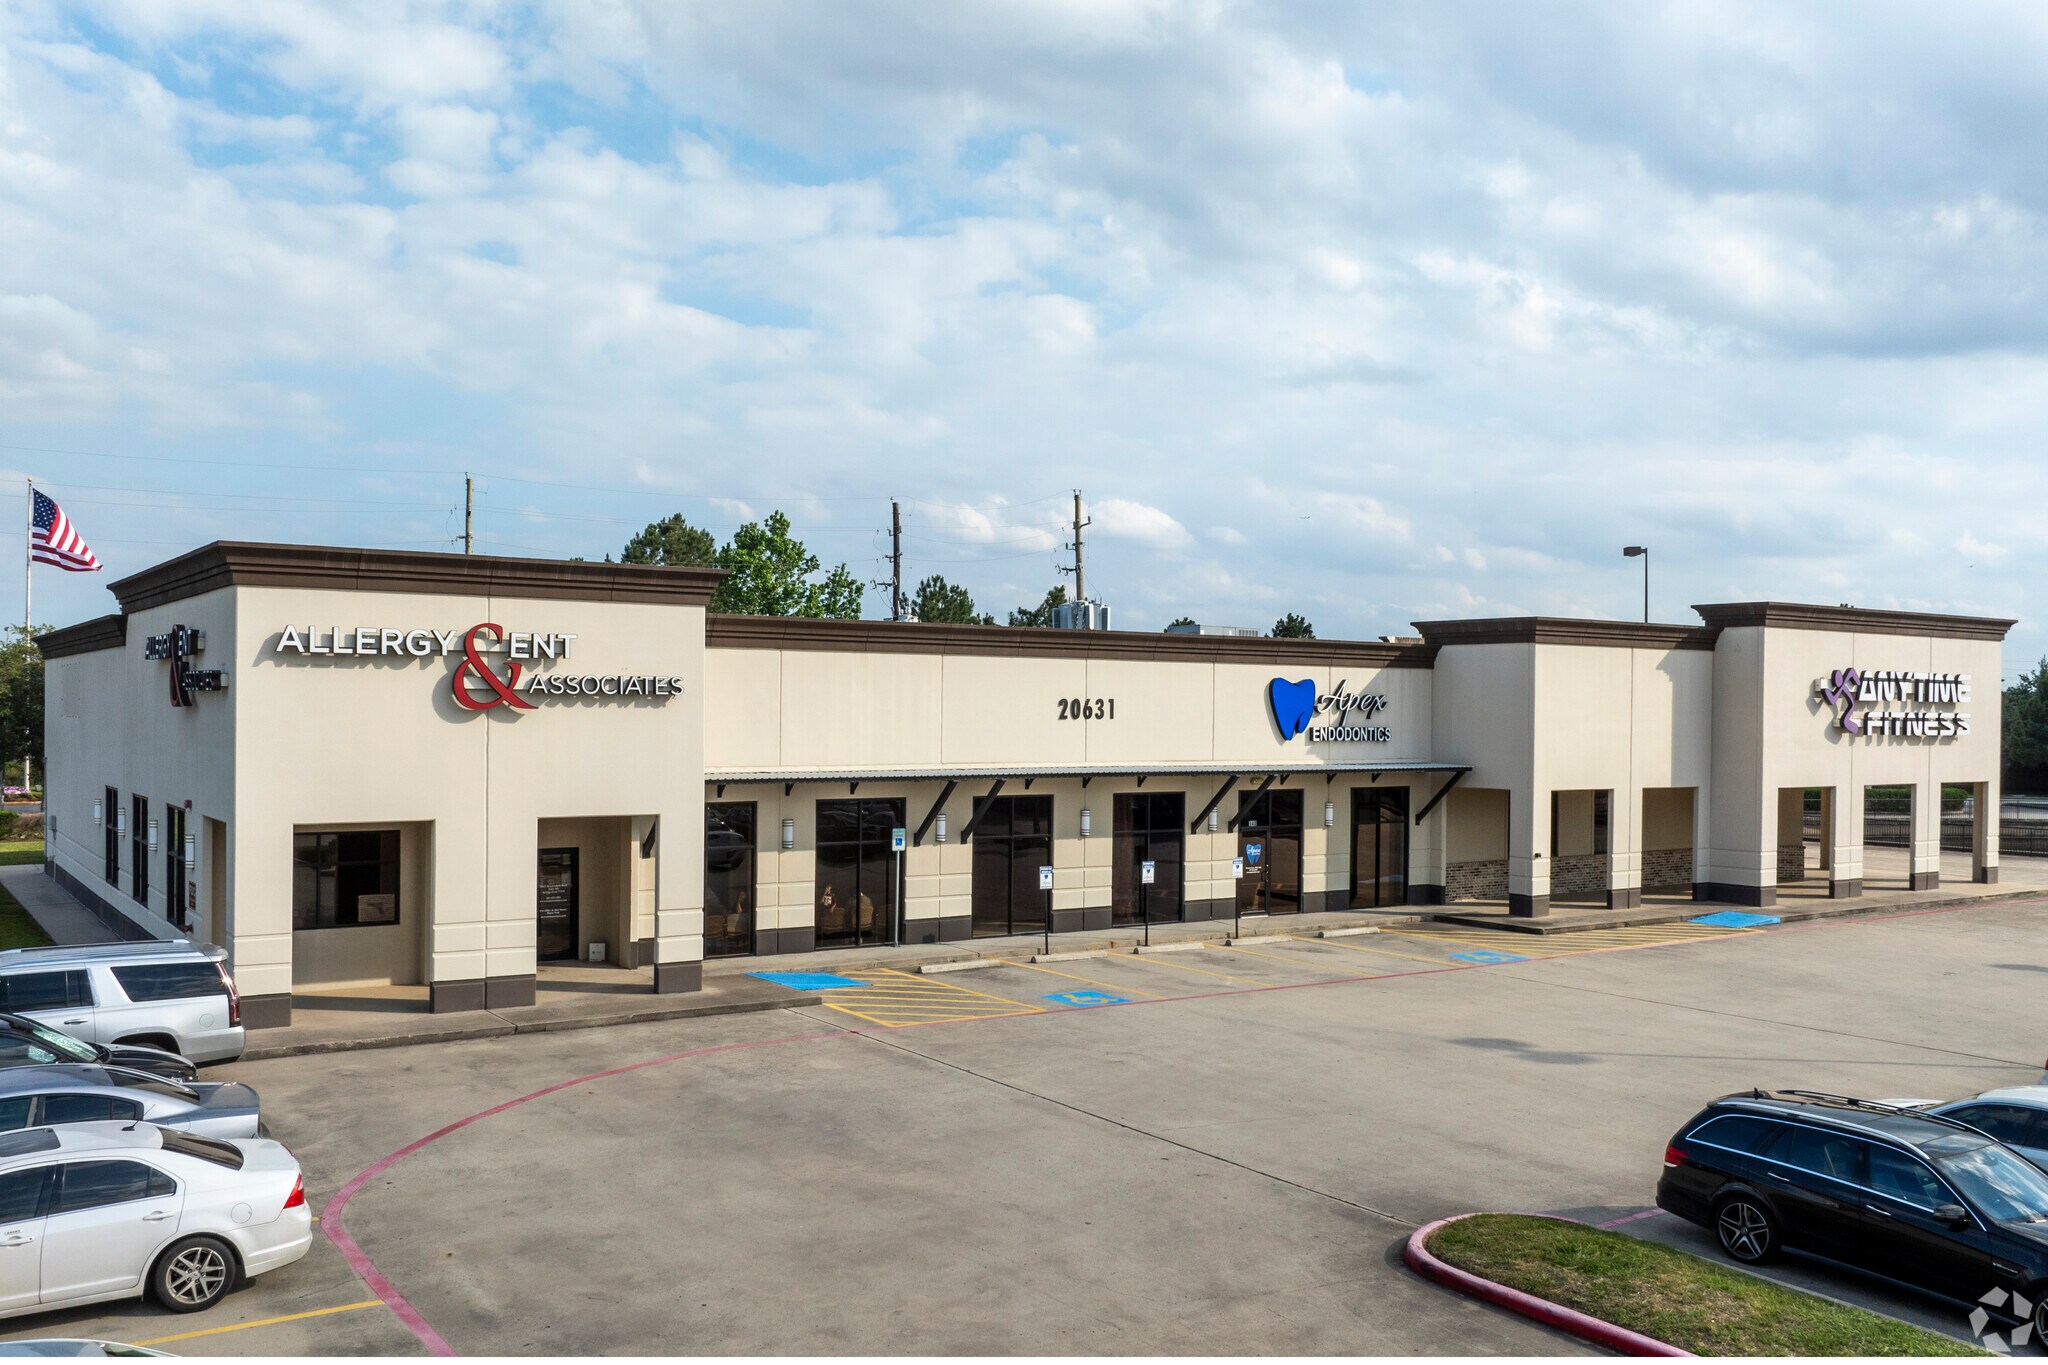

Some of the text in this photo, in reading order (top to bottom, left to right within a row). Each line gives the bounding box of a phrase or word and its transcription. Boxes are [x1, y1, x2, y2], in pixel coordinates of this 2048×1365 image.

[275, 623, 578, 709] ALLERGY & ENT
[528, 674, 685, 696] ASSOCIATES
[1857, 670, 1972, 703] ANYTIME
[1057, 698, 1115, 720] 20631
[1315, 679, 1387, 727] Apex
[1310, 727, 1392, 742] ENDODONTICS
[1864, 711, 1971, 737] FITNESS
